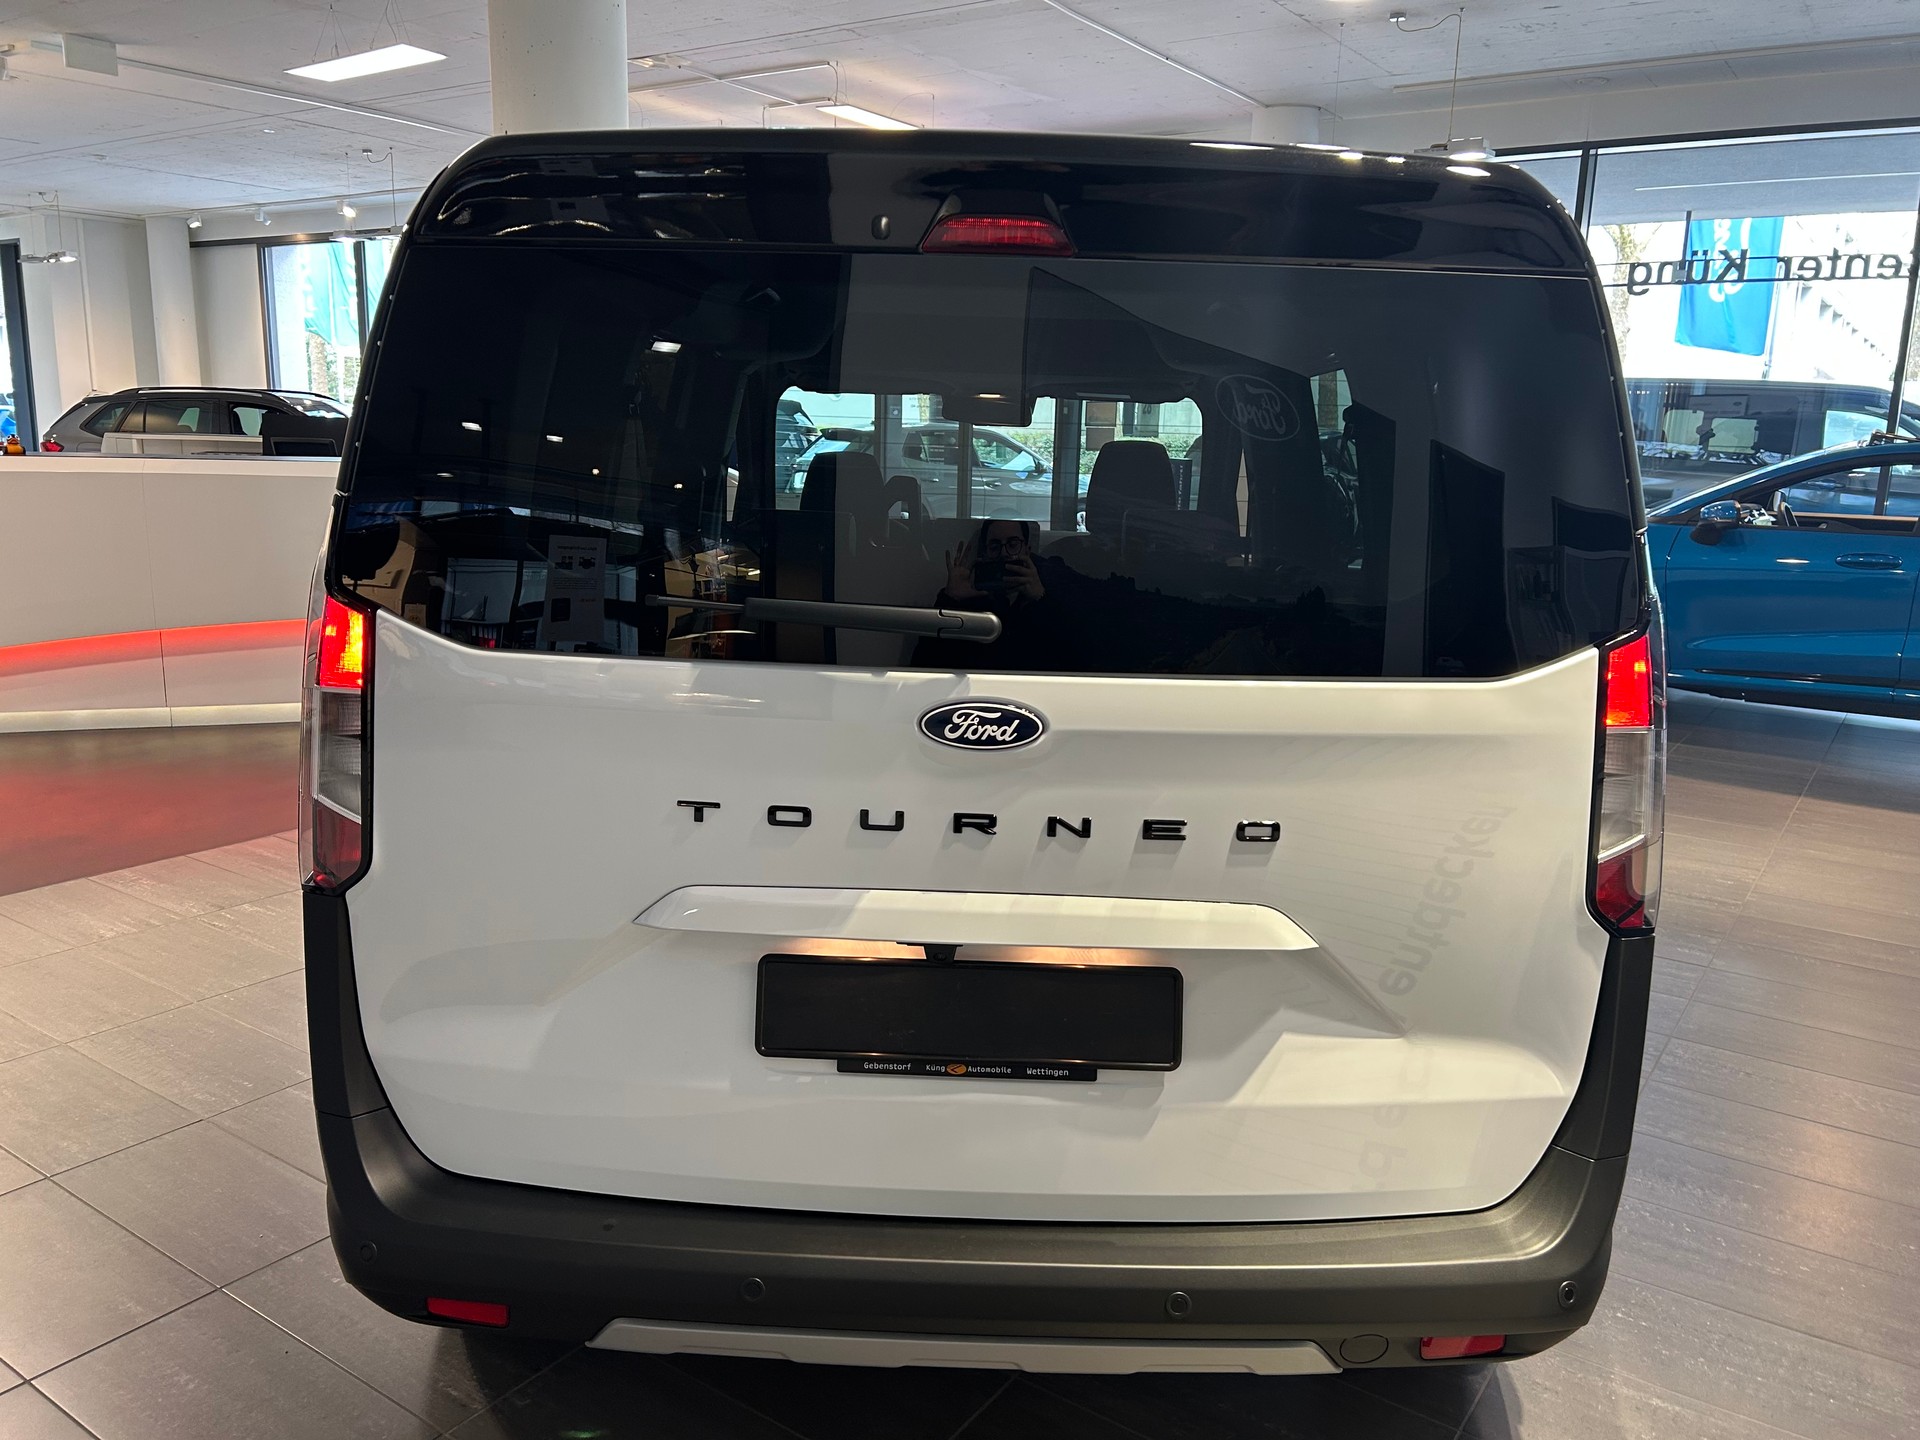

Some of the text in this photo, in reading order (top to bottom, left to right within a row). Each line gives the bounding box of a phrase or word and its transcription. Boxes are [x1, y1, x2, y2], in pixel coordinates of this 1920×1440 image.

[942, 707, 1020, 743] Ford
[676, 800, 1282, 842] TOURNEO
[863, 1061, 1069, 1077] Gebenstorf Küng Automobile Wettingen
